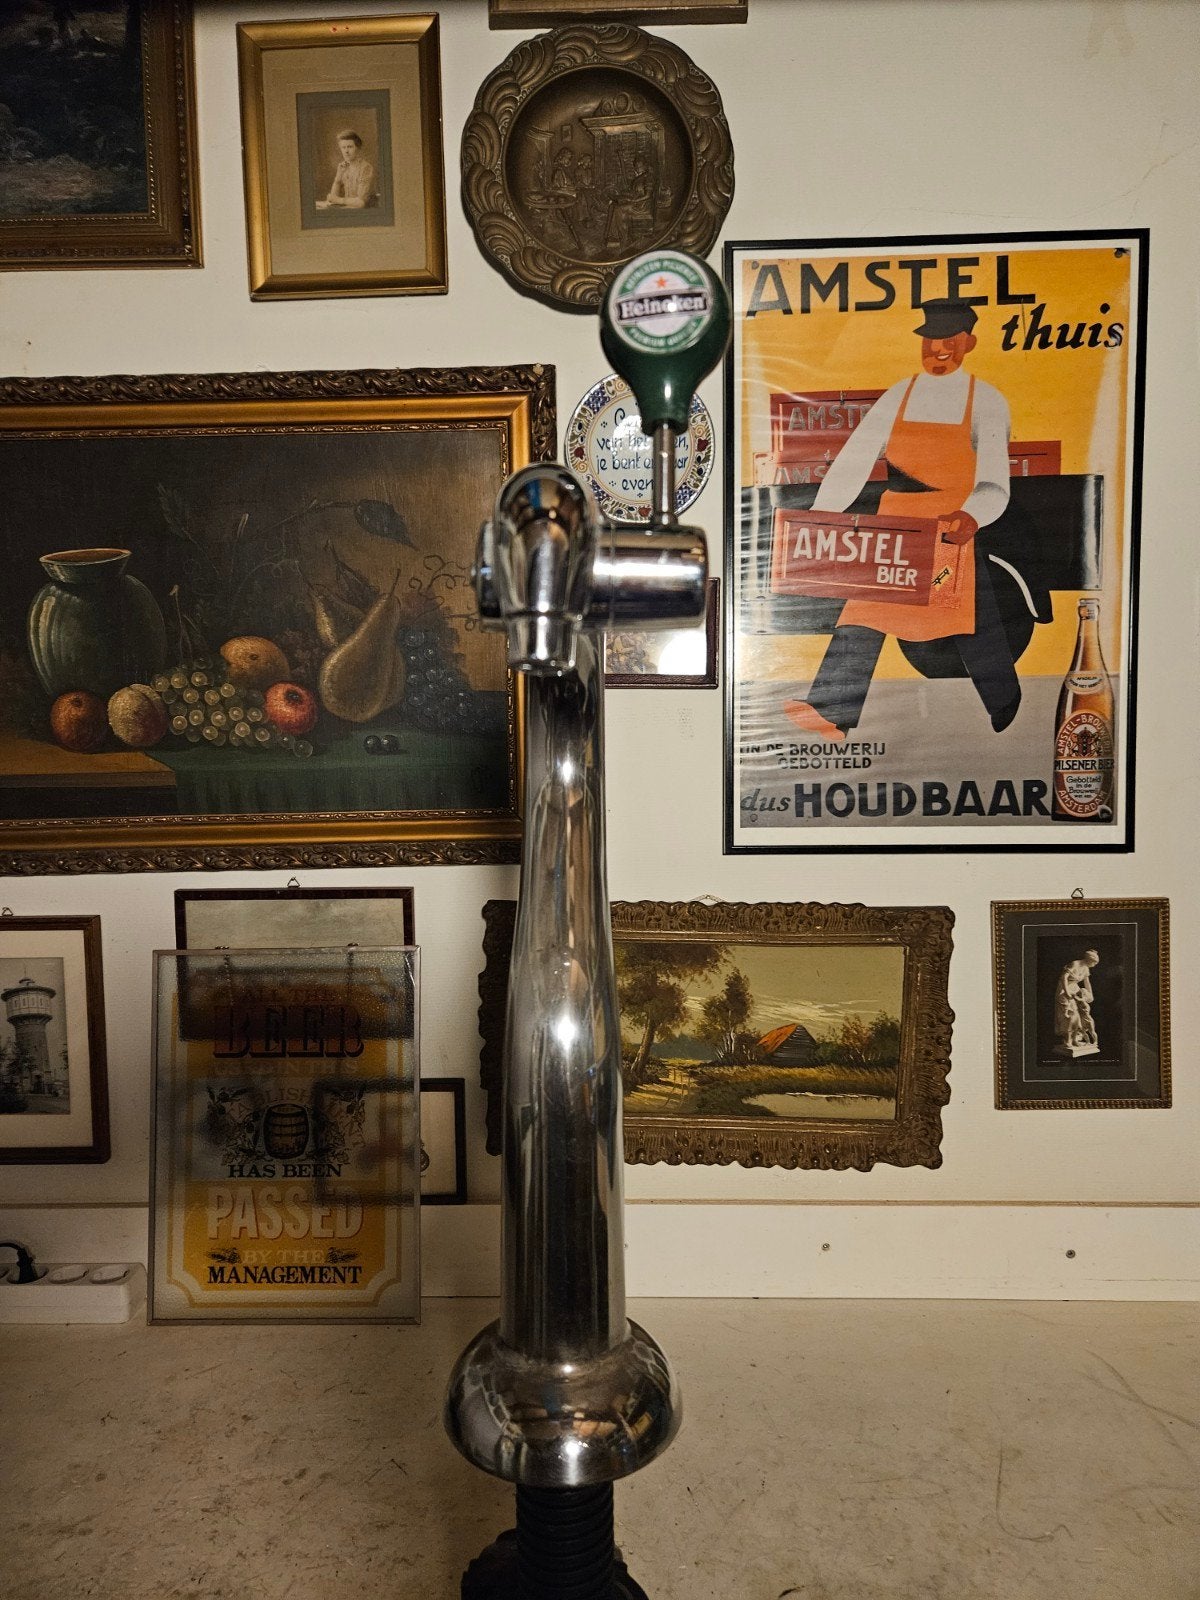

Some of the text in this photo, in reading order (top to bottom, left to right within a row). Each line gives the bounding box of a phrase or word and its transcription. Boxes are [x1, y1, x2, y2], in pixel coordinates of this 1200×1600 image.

[746, 254, 1036, 318] AMSTEL
[620, 294, 706, 319] Heineken
[1002, 302, 1124, 351] thuis
[596, 454, 608, 475] je
[612, 451, 641, 470] bent
[793, 527, 910, 566] AMSTEL
[876, 566, 918, 587] BIER
[789, 742, 886, 756] BROUWERIJ
[778, 756, 872, 770] GEBOTTELD
[1054, 758, 1114, 770] PILSENER BIER
[740, 779, 1054, 818] dus HOUDBAAR
[1058, 790, 1108, 813] AMSTERDAM
[213, 1005, 365, 1058] BEER
[227, 1164, 342, 1179] HAS BEEN
[206, 1186, 365, 1241] PASSED
[242, 1250, 326, 1265] BY THE
[207, 1266, 363, 1285] MANAGEMENT
